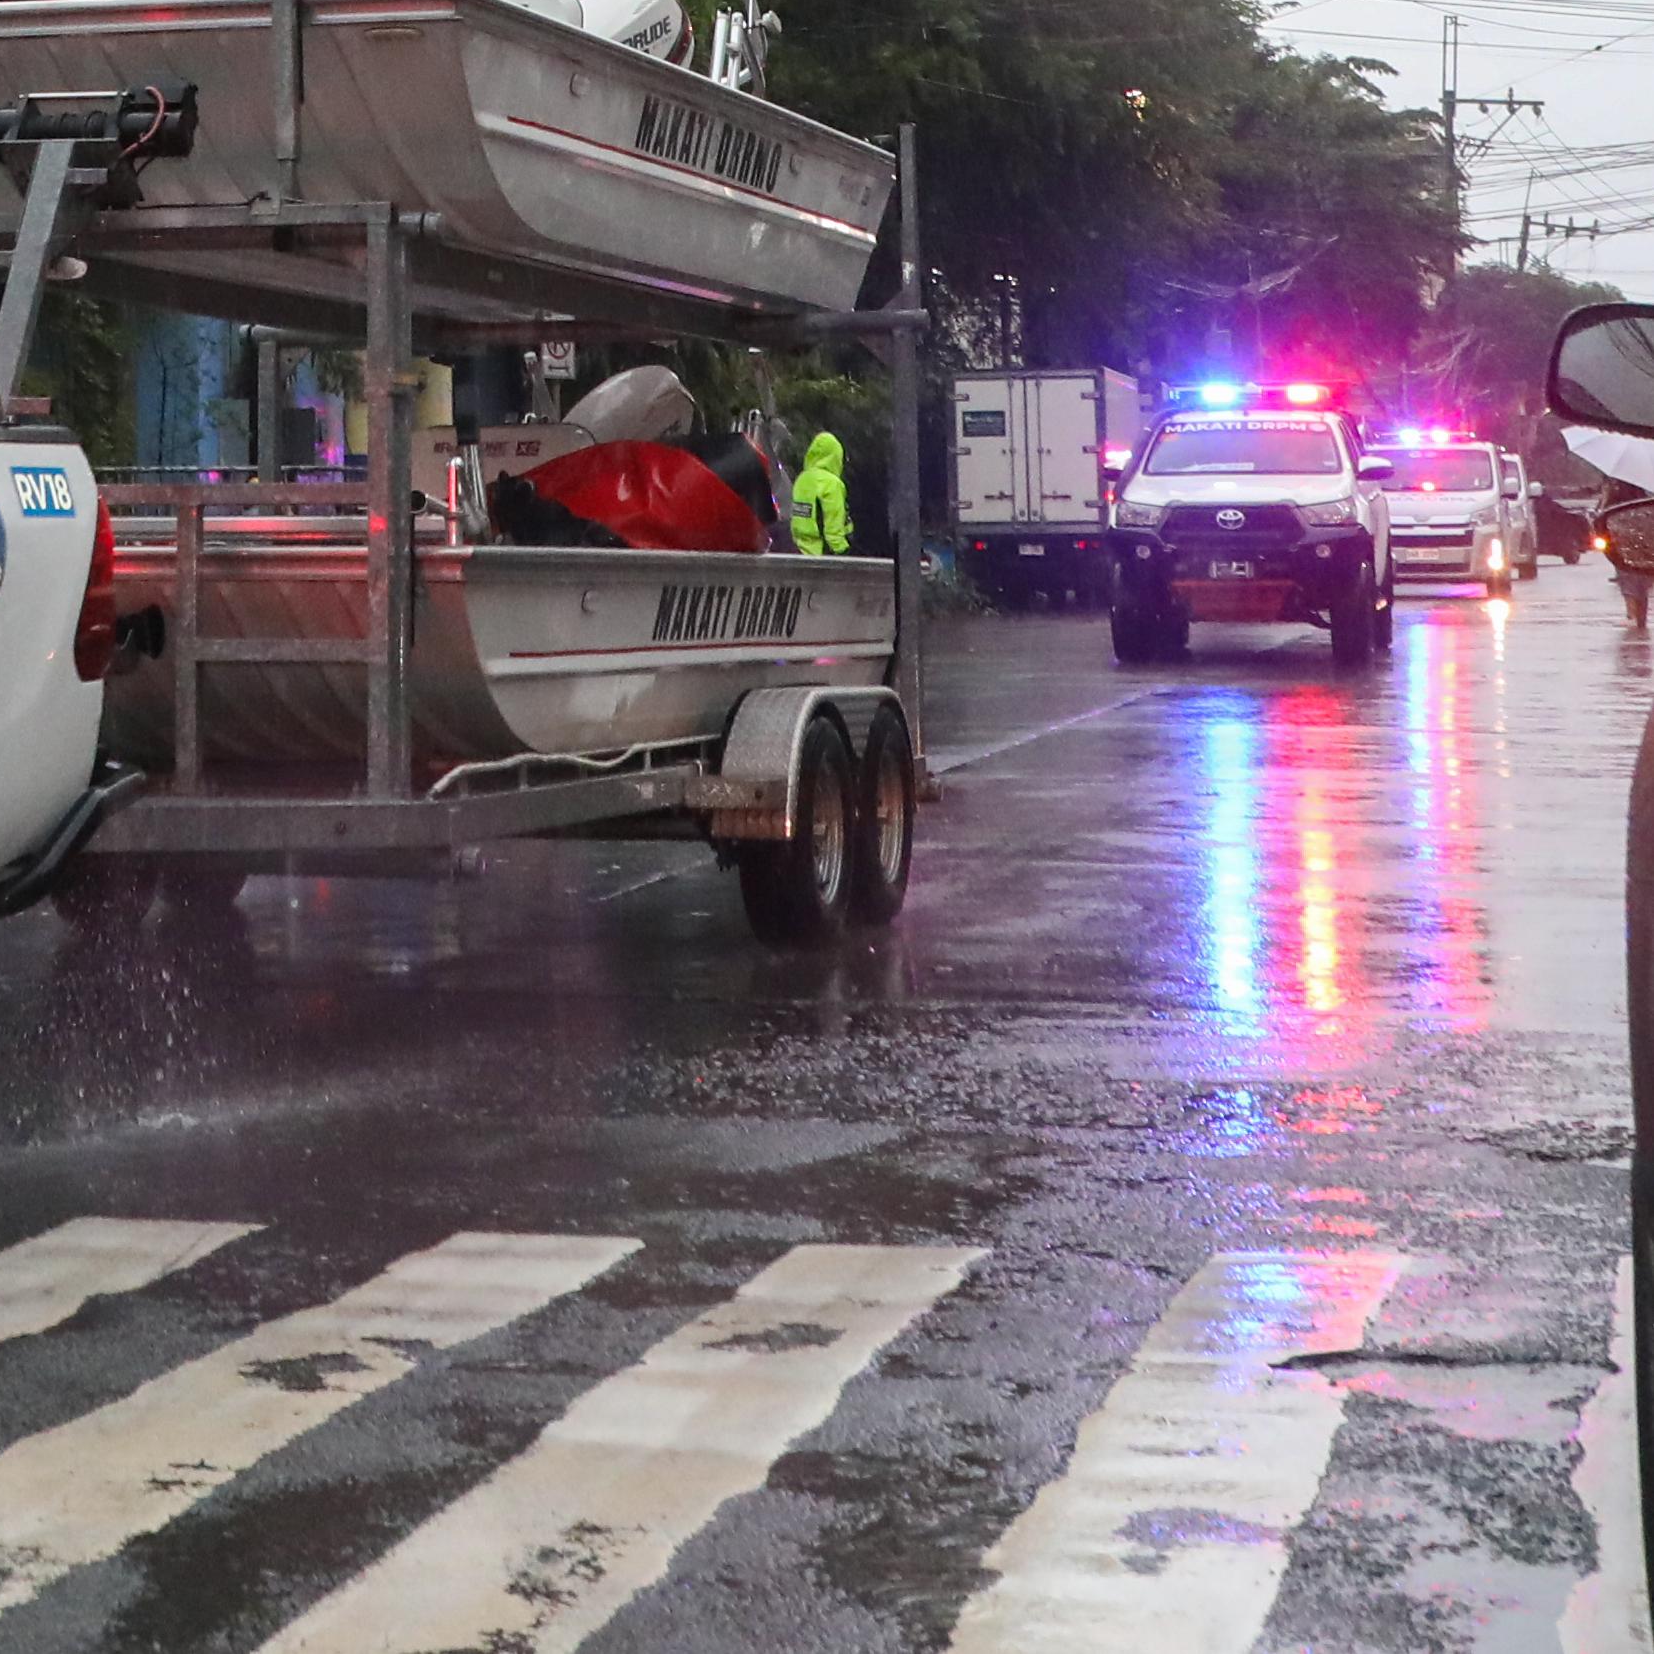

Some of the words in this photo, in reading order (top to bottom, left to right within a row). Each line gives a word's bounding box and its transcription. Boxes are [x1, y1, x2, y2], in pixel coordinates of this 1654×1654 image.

[635, 94, 716, 170] MAKATI
[715, 122, 782, 193] DRRMO
[1165, 421, 1241, 433] MAKATI
[15, 473, 72, 510] RV18
[652, 585, 734, 641] MAKATI
[734, 586, 803, 639] DRRMO
